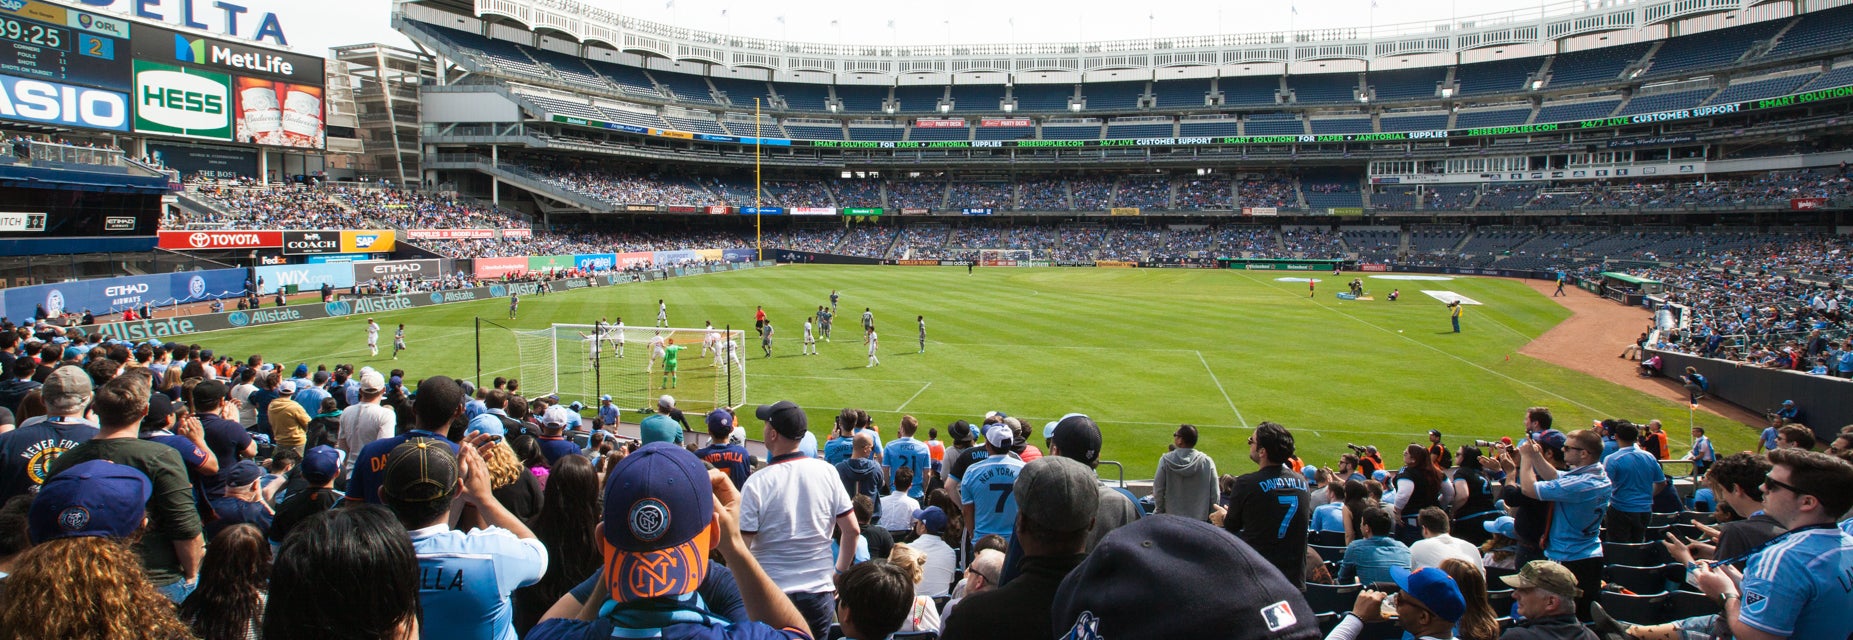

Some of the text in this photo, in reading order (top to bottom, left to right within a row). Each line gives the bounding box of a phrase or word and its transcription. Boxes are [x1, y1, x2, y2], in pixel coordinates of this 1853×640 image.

[80, 0, 288, 46] ELTA
[94, 20, 119, 32] ORL
[13, 42, 41, 53] CORNERS
[89, 38, 103, 56] 2
[17, 51, 36, 59] FOULS
[211, 45, 293, 75] MetLife
[17, 58, 36, 67] SHOTS
[31, 67, 53, 76] TARGET
[143, 84, 222, 115] HESS
[1758, 94, 1796, 109] SMART
[1580, 103, 1741, 129] 24/7 LIVE CUSTOMER SUPPORT
[1467, 123, 1558, 136] 2RISESUPPLIES.COM
[1178, 137, 1212, 145] SUPPORT
[1253, 135, 1296, 143] SOLUTIONS
[1318, 134, 1343, 142] PAPER
[1354, 133, 1406, 141] JANITORIAL
[1409, 130, 1448, 139] SUPPLIES
[198, 169, 215, 177] THE
[211, 233, 260, 245] TOYOTA
[287, 241, 336, 249] COACH
[356, 235, 374, 248] SAP
[261, 255, 287, 265] FedEx
[373, 262, 421, 273] ETIHAD
[276, 269, 333, 285] WIX.com
[105, 283, 149, 297] ETIHAD
[444, 290, 474, 303] Allstate
[112, 295, 141, 306] AIRWAYS
[354, 293, 411, 314] Allstate
[251, 308, 300, 324] Allstate
[97, 317, 194, 340] Allstate
[20, 438, 55, 459] NEVER
[370, 452, 390, 472] DA
[723, 451, 743, 463] VILLA
[979, 467, 1015, 484] NEW YORK
[1259, 477, 1285, 493] DAVID
[989, 483, 1014, 513] 7
[1277, 495, 1299, 539] 7
[1747, 592, 1760, 600] MLS
